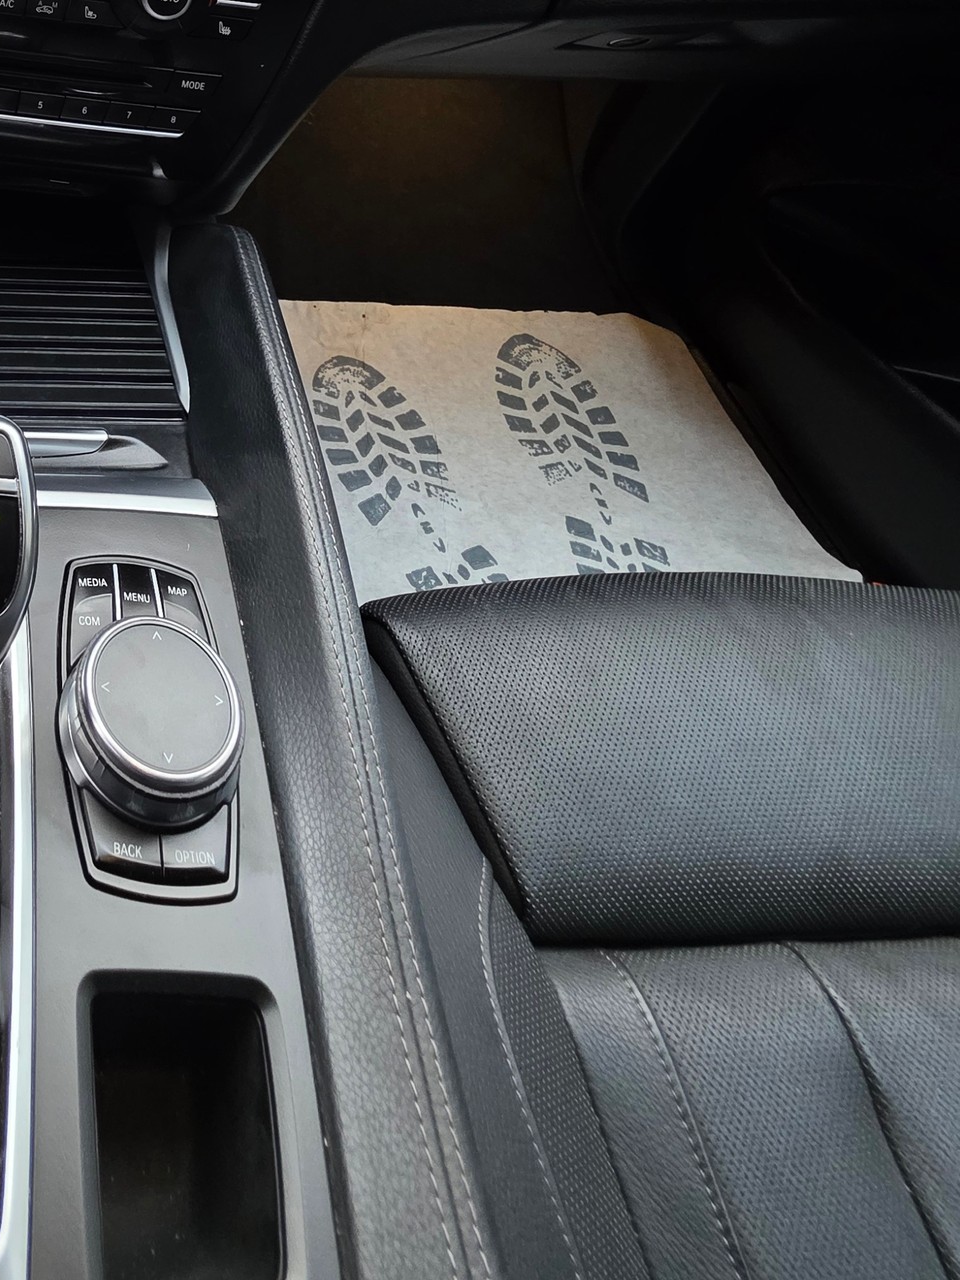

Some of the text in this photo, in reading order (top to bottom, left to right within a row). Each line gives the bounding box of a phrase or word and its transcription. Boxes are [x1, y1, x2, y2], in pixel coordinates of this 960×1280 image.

[181, 80, 205, 91] MODE
[37, 100, 43, 109] 5
[82, 106, 88, 115] 6
[126, 110, 132, 119] 7
[170, 115, 177, 124] 8
[78, 577, 108, 588] MEDIA
[167, 585, 188, 597] MAP
[123, 591, 151, 604] MENU
[78, 616, 101, 627] COM
[113, 841, 143, 859] BACK
[174, 849, 216, 866] OPTION
